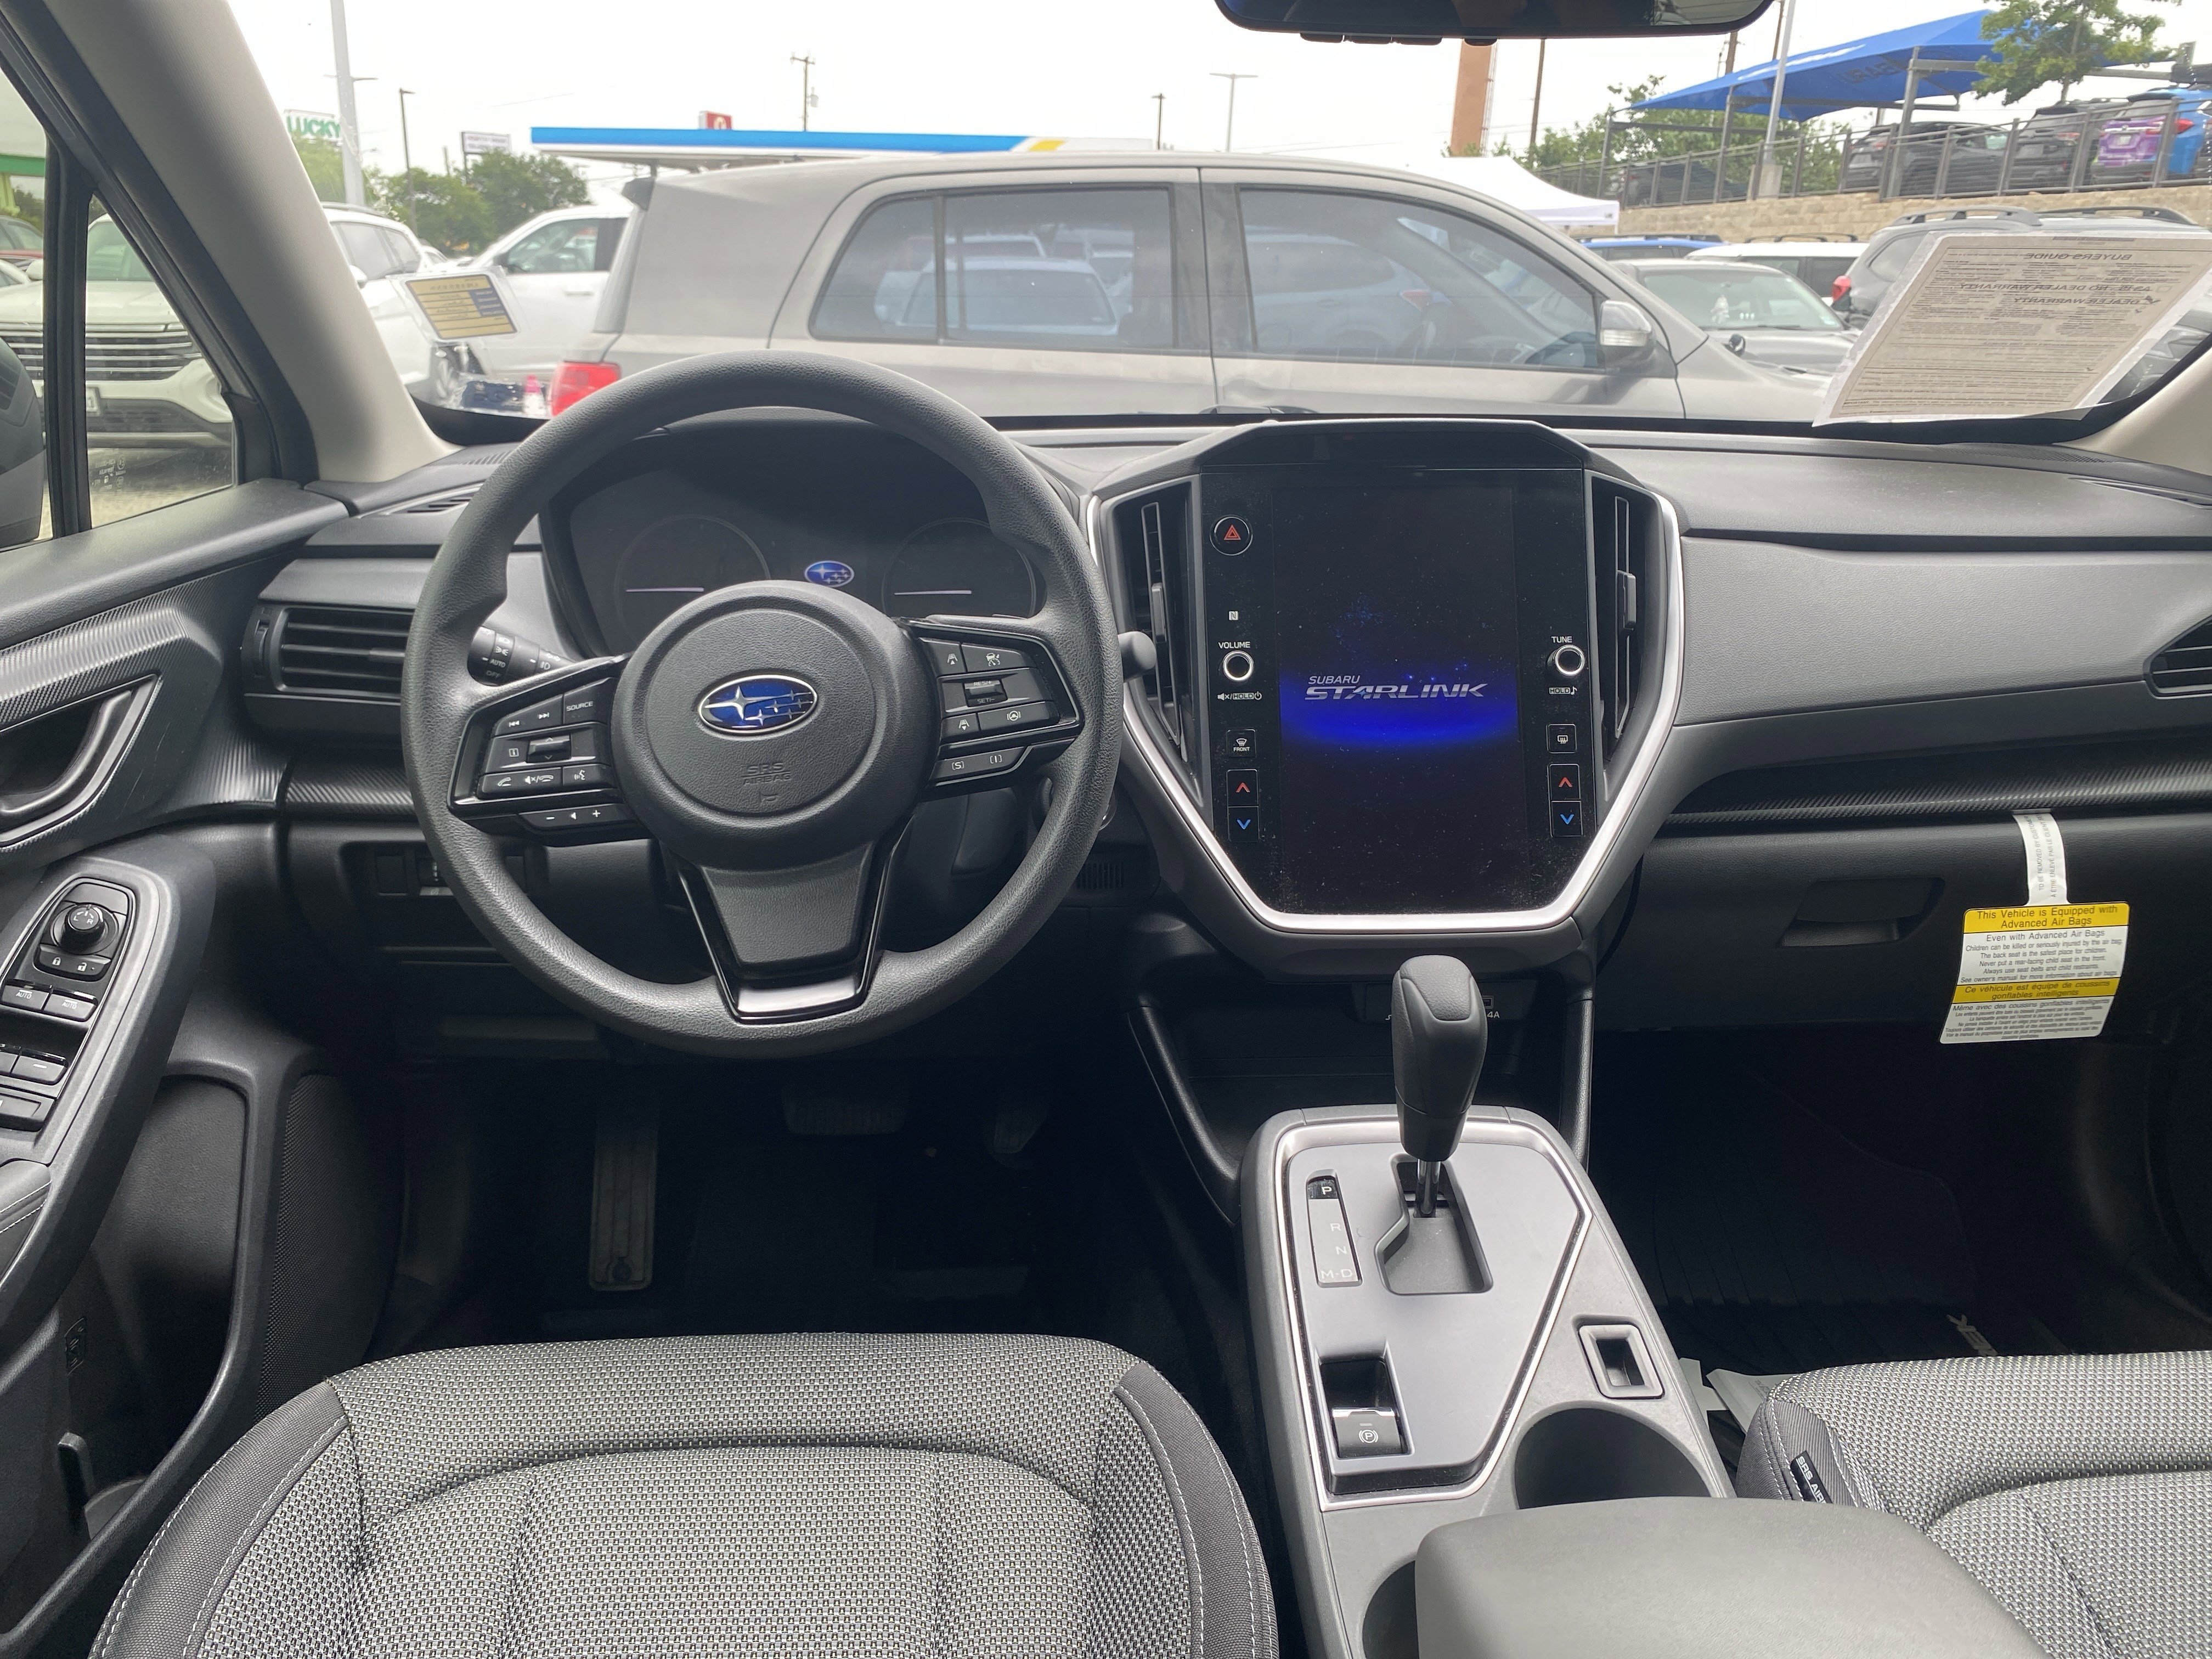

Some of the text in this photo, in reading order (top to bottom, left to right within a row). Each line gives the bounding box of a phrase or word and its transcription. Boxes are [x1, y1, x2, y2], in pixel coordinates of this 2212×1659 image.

[286, 115, 341, 138] LUCKY
[1218, 641, 1251, 649] VOLUME
[1308, 675, 1360, 685] SUBARU
[1305, 683, 1488, 700] STARLINK
[566, 701, 593, 712] SOURCE
[747, 761, 785, 776] SRS
[742, 772, 792, 786] AIRBAG
[2040, 822, 2051, 837] CLIENT
[1977, 910, 1996, 919] This
[2000, 909, 2034, 918] Vehicle
[2051, 906, 2095, 917] Equipped
[2098, 905, 2118, 913] with
[2001, 917, 2092, 928] Advanced Air Bags
[2028, 930, 2068, 939] Advanced
[2085, 929, 2105, 938] Bags
[15, 991, 32, 999] AUTO
[1991, 991, 2033, 1000] gonflables
[61, 1001, 77, 1009] AUTO
[1321, 1186, 1332, 1195] P
[1330, 1223, 1341, 1232] R
[1335, 1246, 1347, 1255] N
[1797, 1455, 1813, 1480] SRS
